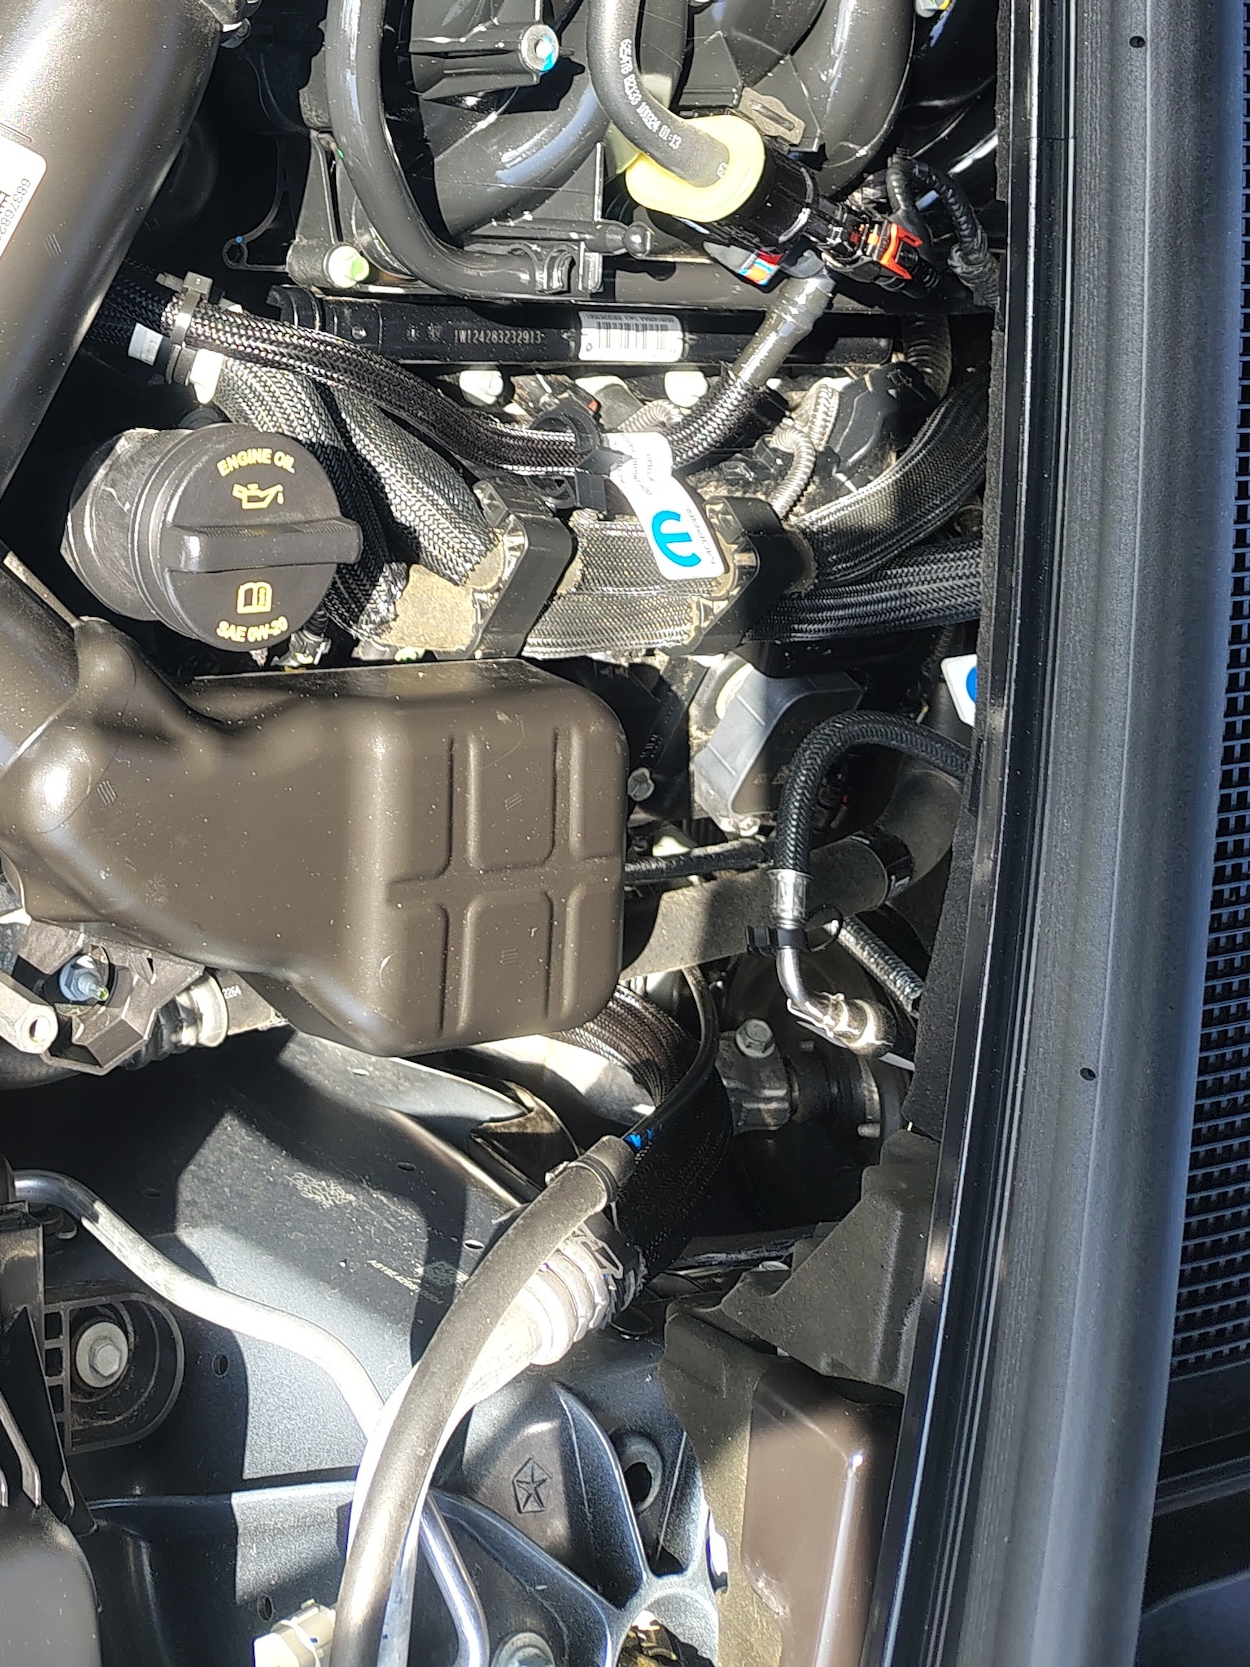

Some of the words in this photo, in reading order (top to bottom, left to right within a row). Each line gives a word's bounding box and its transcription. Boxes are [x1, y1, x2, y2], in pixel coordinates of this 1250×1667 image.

[658, 125, 682, 149] 01:13
[216, 448, 271, 477] ENGINE
[274, 451, 296, 475] OIL
[216, 620, 245, 643] SAE
[248, 616, 288, 643] 0W-20
